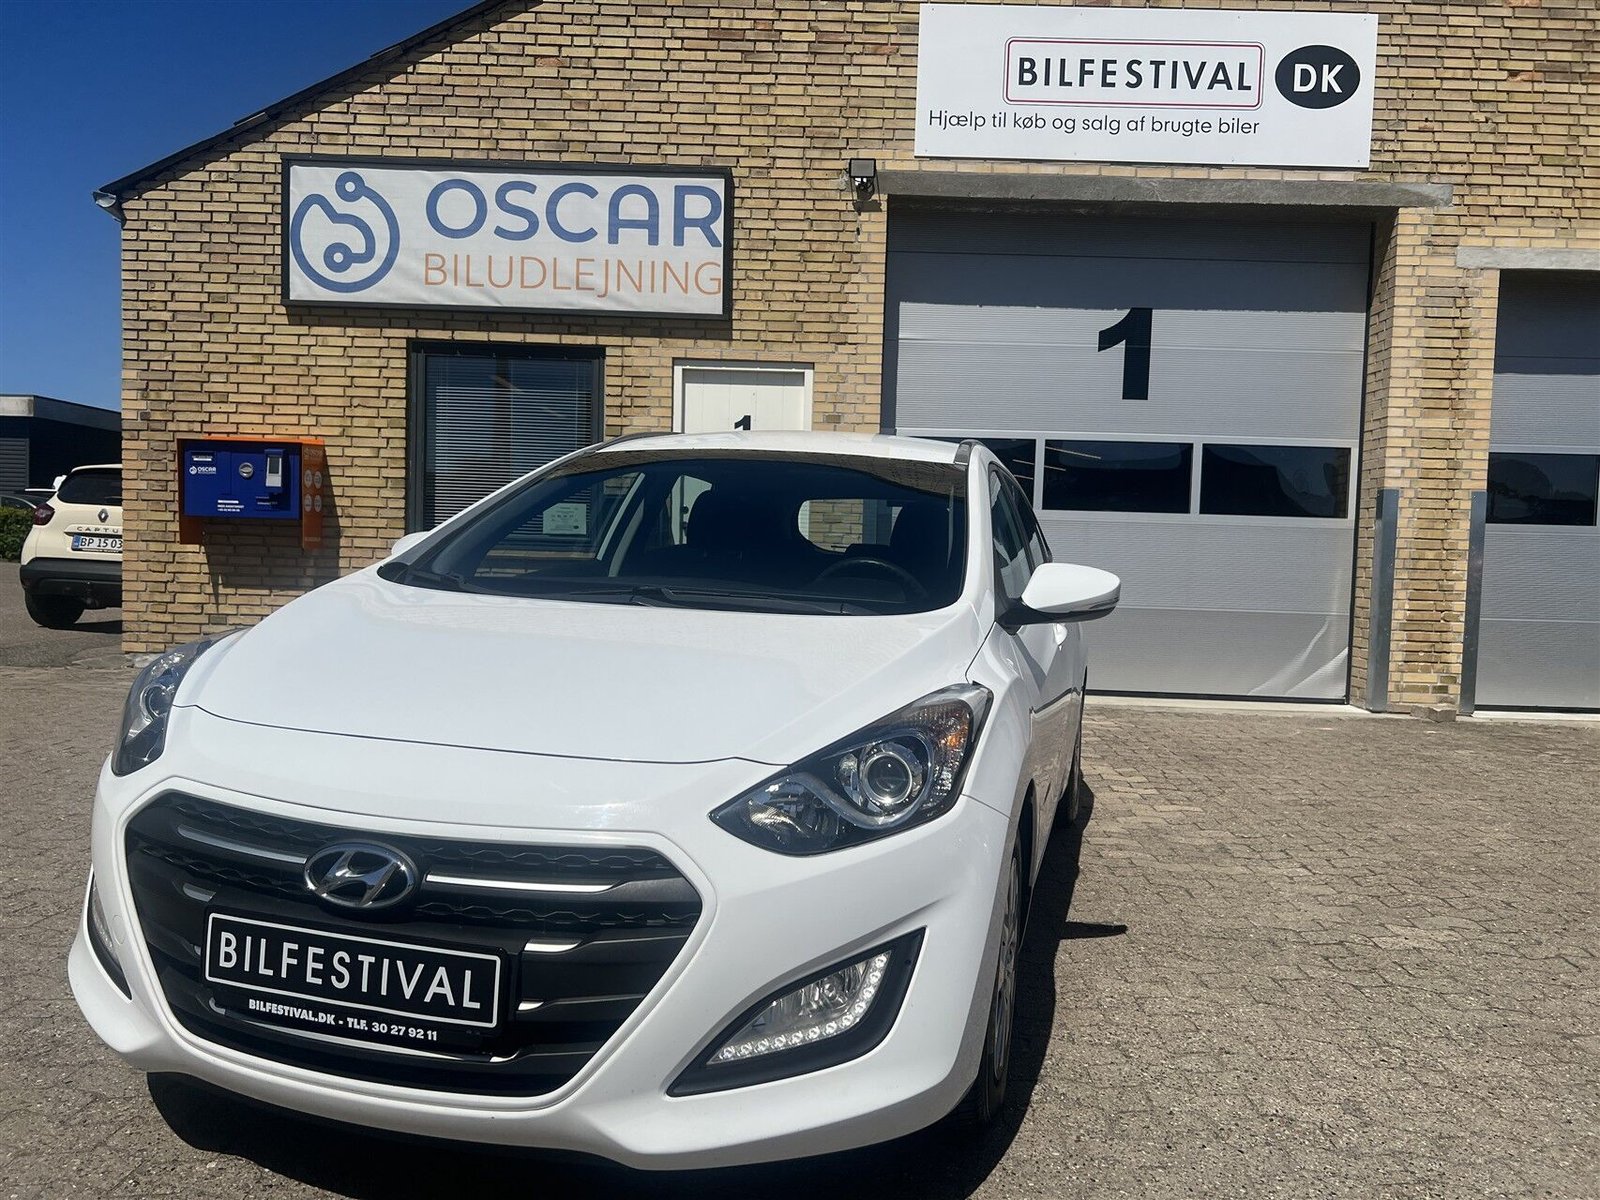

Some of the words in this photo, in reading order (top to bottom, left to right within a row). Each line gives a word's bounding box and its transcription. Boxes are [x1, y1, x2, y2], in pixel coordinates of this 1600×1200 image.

[1018, 57, 1251, 91] BILFESTIVAL
[1293, 63, 1344, 94] DK
[929, 110, 986, 131] Hjælp
[992, 112, 1006, 128] til
[1013, 112, 1046, 130] køb
[1052, 117, 1076, 134] og
[1082, 115, 1121, 135] salg
[1127, 116, 1146, 132] af
[1151, 116, 1212, 137] brugte
[1218, 117, 1260, 134] biler
[425, 178, 722, 248] OSCAR
[423, 252, 722, 298] BILUDLEJNING
[1098, 307, 1152, 400] 1
[80, 538, 95, 547] BP
[97, 538, 109, 548] 15
[219, 931, 481, 1009] BILFESTIVAL
[249, 999, 336, 1026] BILFESTIVAL.DK
[347, 1017, 369, 1031] TLF.
[371, 1022, 388, 1034] 30
[390, 1024, 406, 1036] 27
[408, 1028, 425, 1040] 92
[426, 1030, 437, 1042] 11
